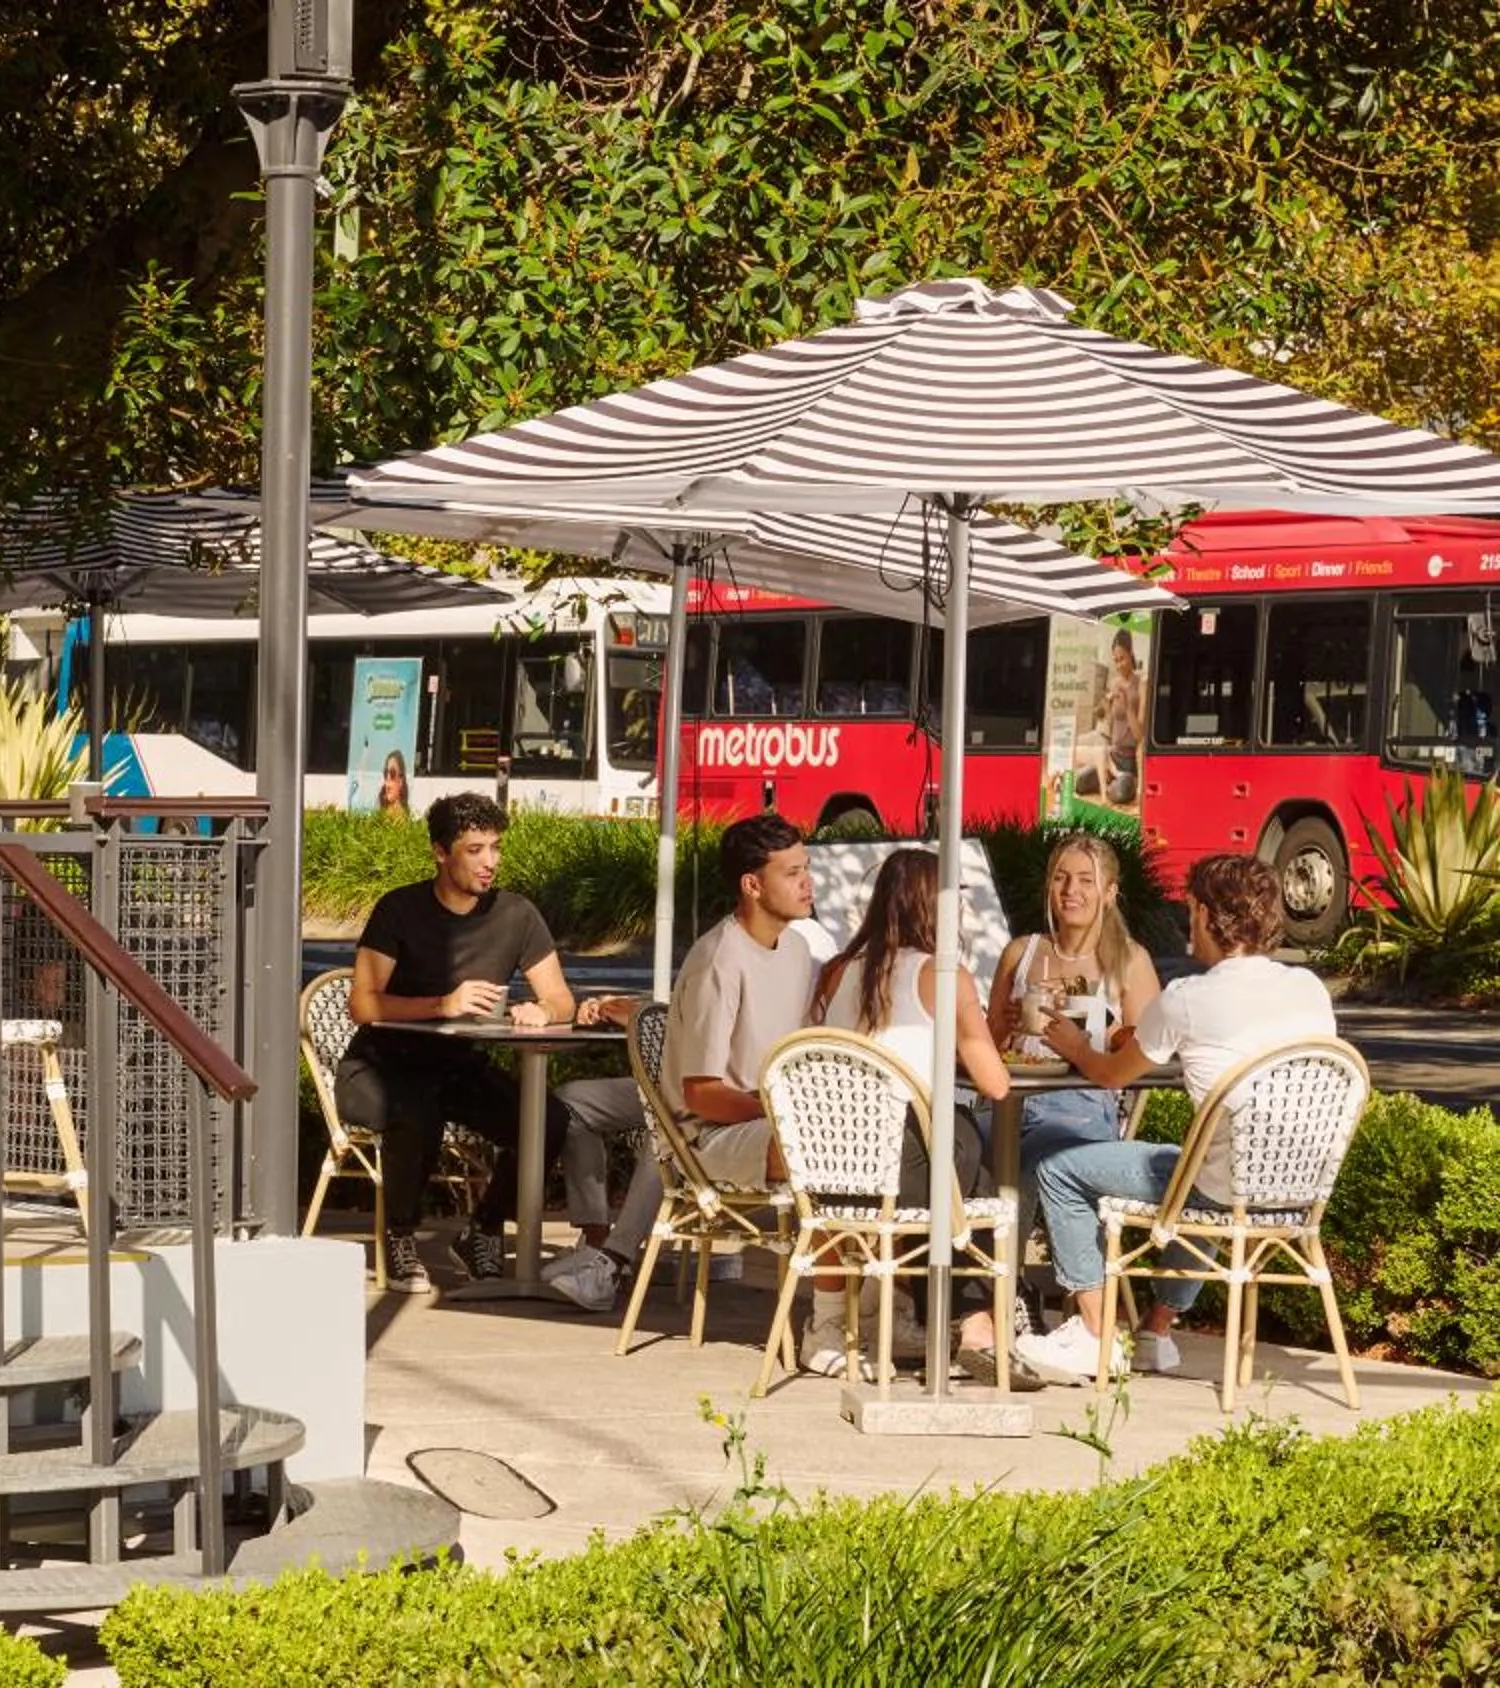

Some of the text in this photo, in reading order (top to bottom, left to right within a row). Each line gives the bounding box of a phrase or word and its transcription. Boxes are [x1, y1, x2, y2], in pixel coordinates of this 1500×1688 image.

[1231, 563, 1266, 580] School
[1274, 562, 1302, 579] Sport
[1311, 561, 1346, 577] Dinner
[1355, 559, 1393, 576] Friends
[699, 723, 840, 766] metrobus
